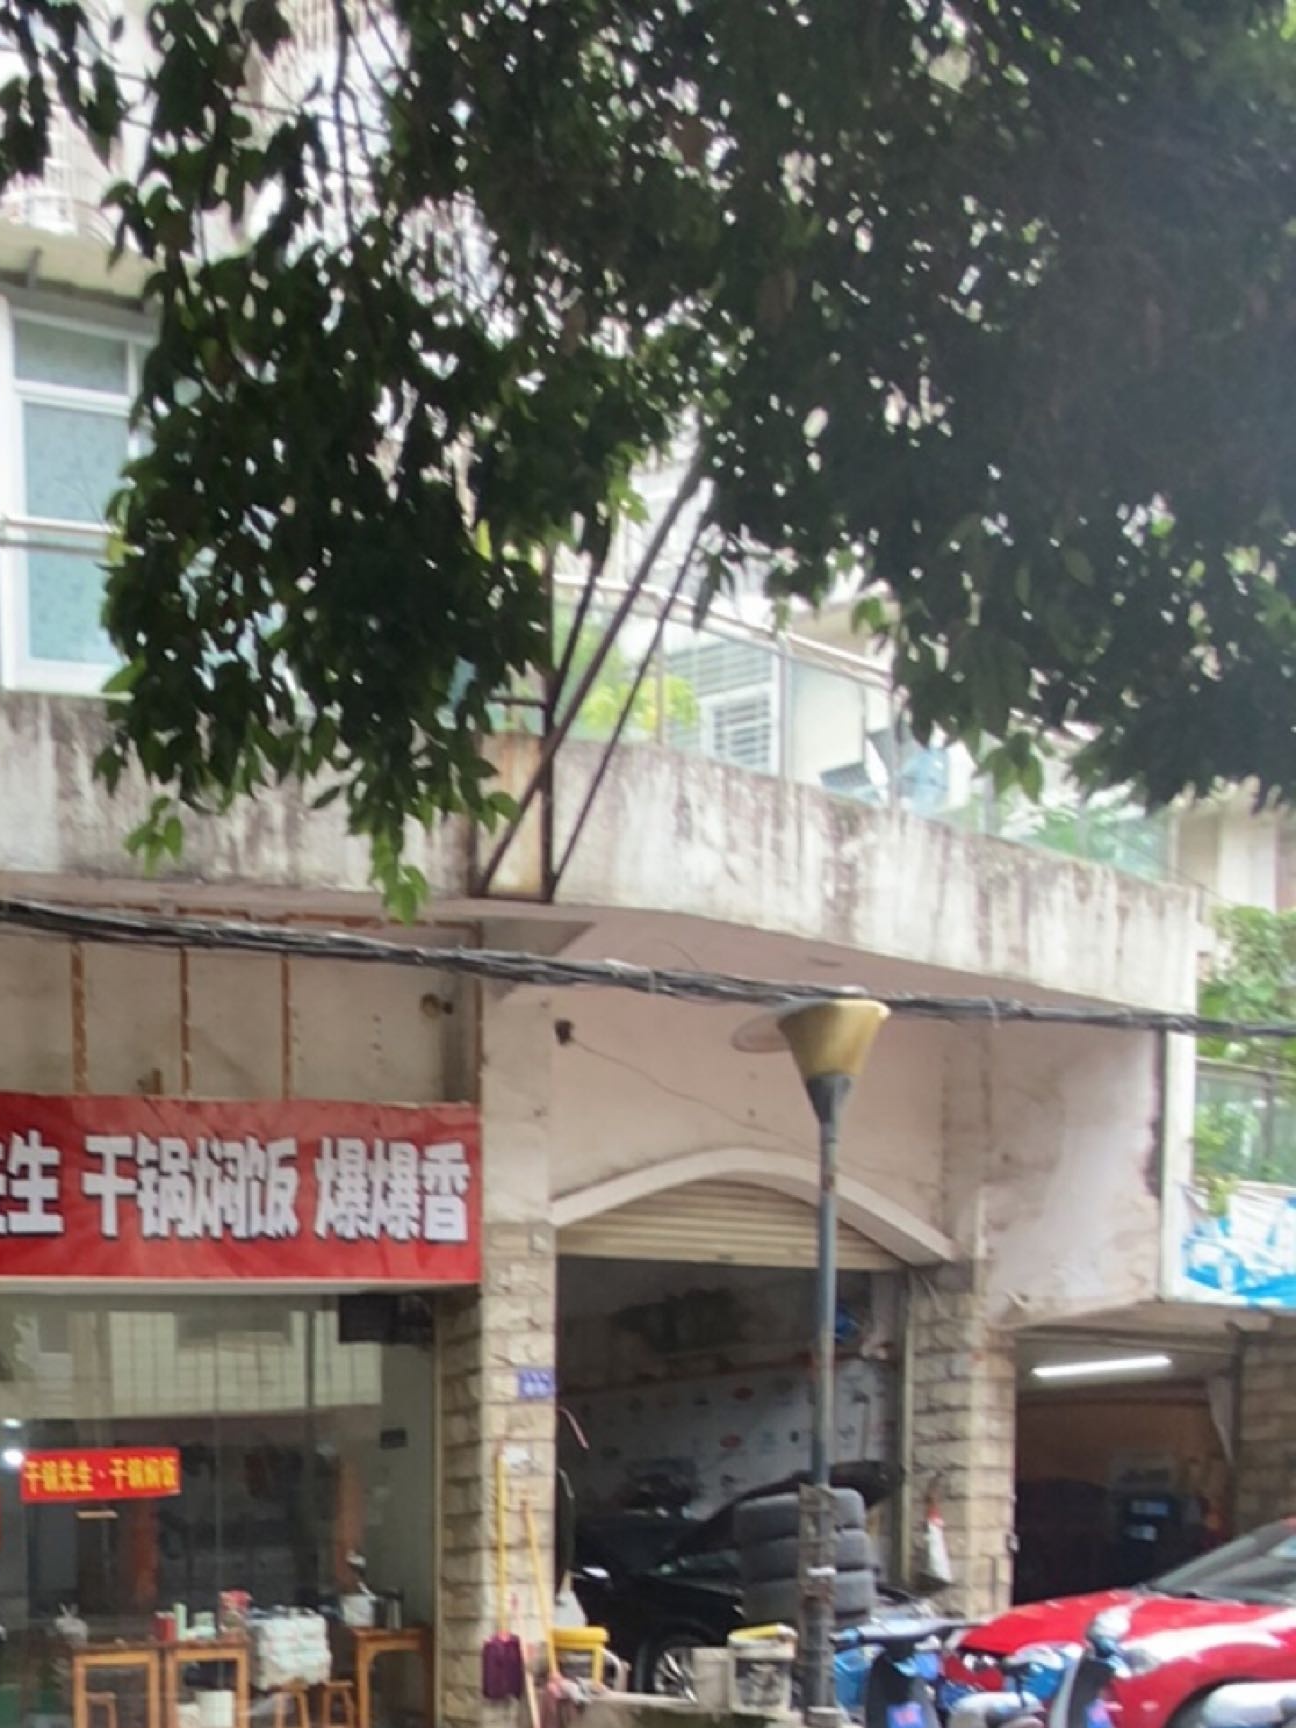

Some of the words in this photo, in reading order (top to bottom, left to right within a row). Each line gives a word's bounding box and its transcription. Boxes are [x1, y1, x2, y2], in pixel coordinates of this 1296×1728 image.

[81, 1131, 299, 1240] 干锅焖饭
[313, 1136, 470, 1243] 爆爆香
